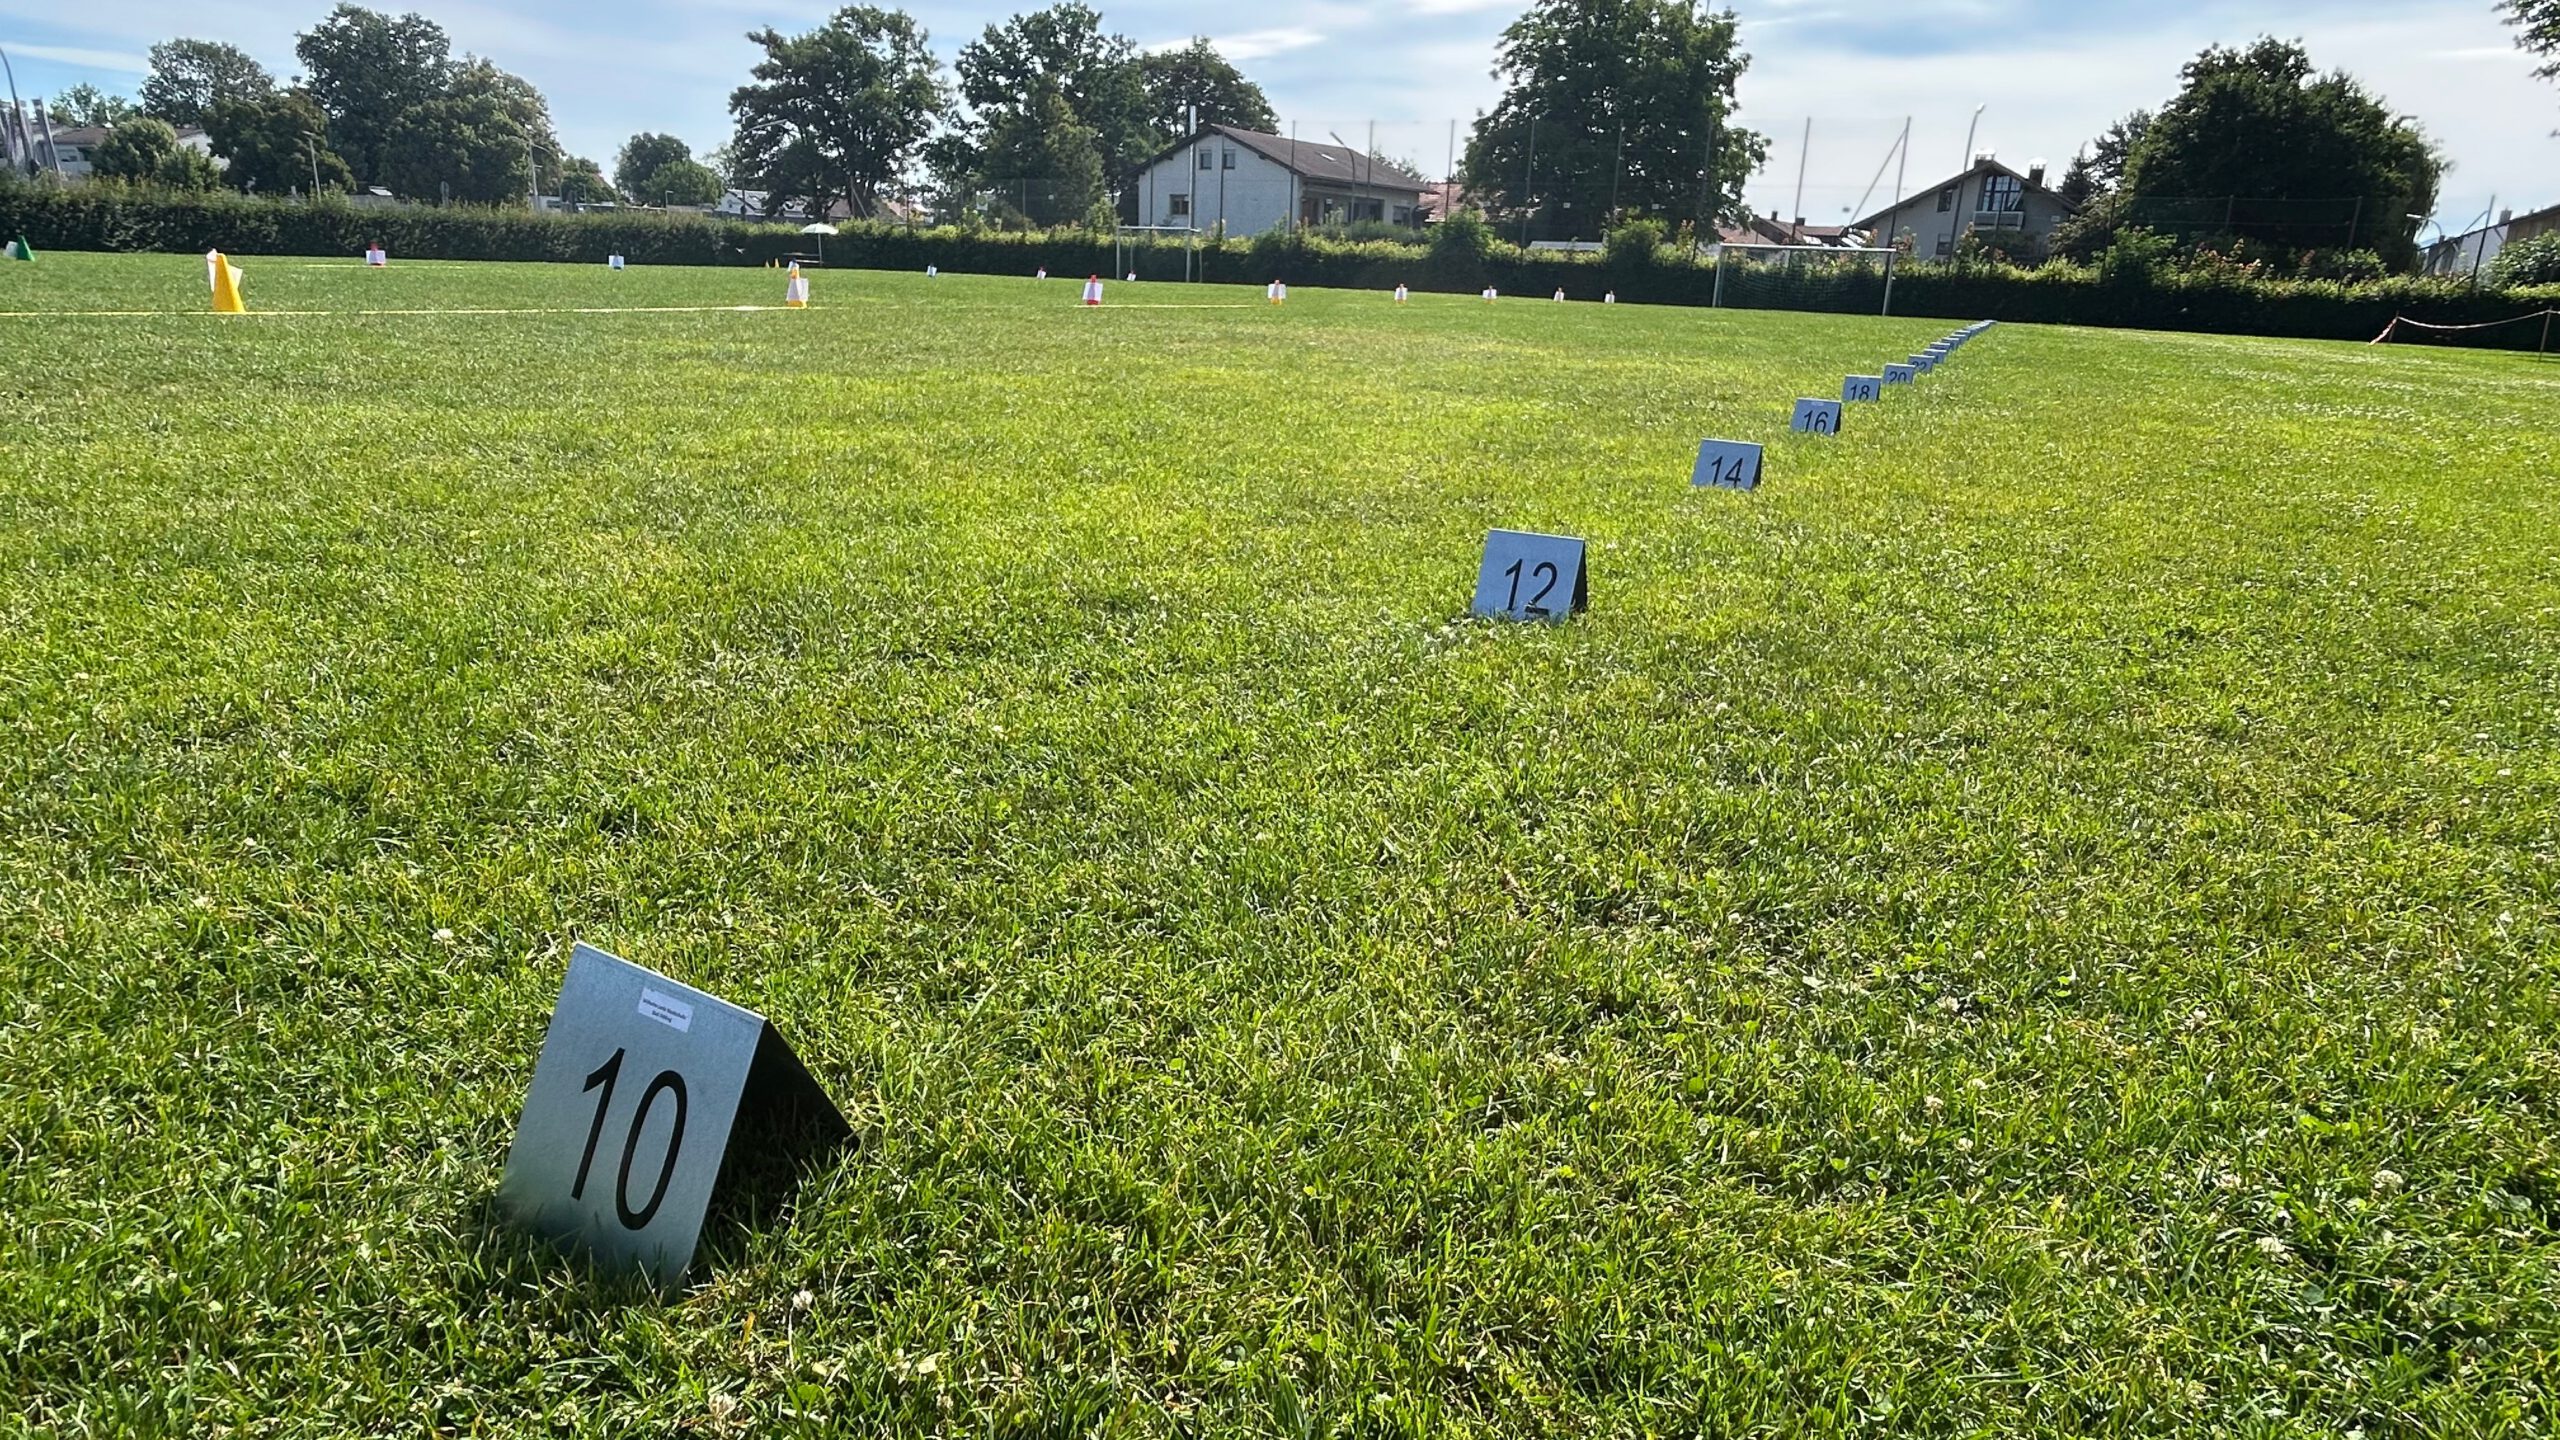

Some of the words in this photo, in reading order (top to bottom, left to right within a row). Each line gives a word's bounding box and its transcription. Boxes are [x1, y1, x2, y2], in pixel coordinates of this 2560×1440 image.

[1888, 371, 1907, 385] 20
[1850, 384, 1870, 402] 18
[1804, 410, 1829, 433] 16
[1711, 456, 1743, 488] 14
[1505, 559, 1557, 615] 12
[571, 1047, 688, 1230] 10
